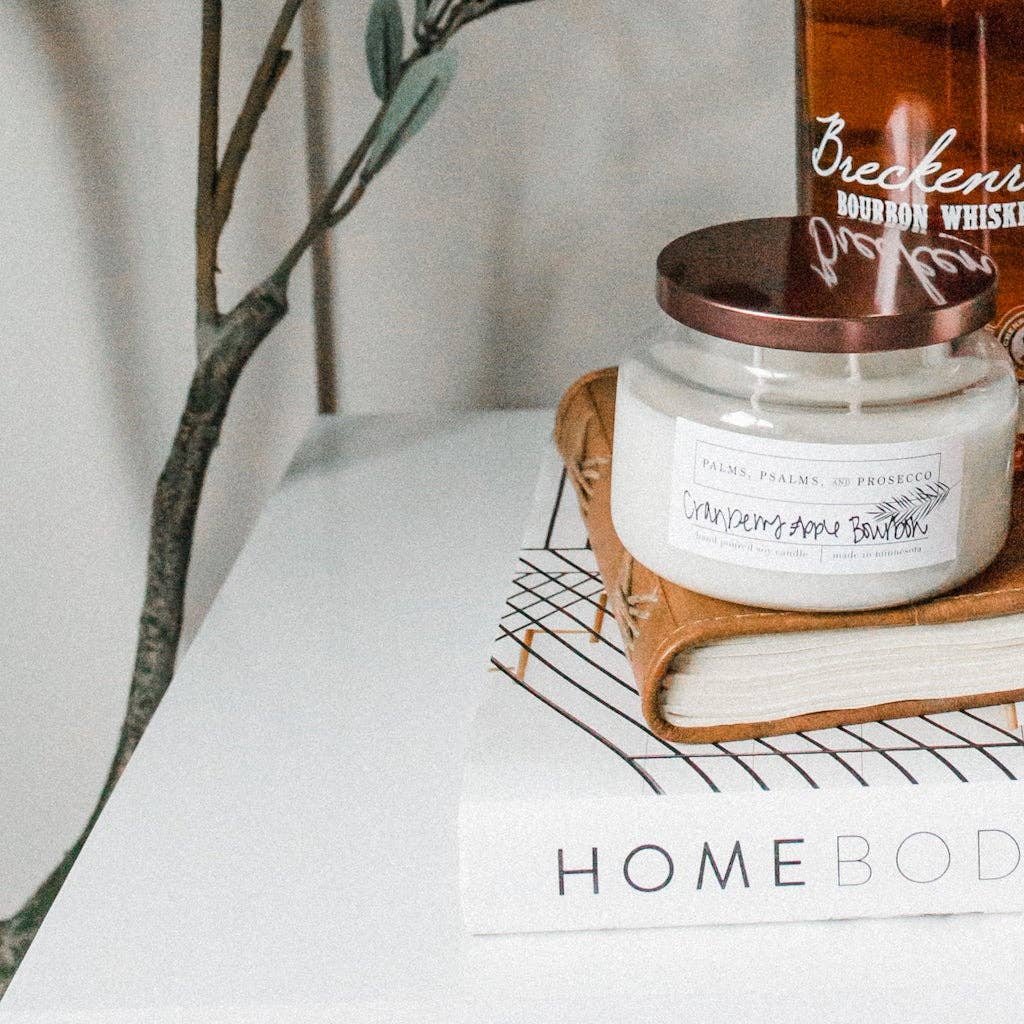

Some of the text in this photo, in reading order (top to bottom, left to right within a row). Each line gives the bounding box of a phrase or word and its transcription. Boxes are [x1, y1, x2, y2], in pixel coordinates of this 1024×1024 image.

[836, 190, 929, 234] BOURBON
[857, 470, 933, 487] PROSECCO
[683, 489, 929, 544] Cranberry Apple Bourbon
